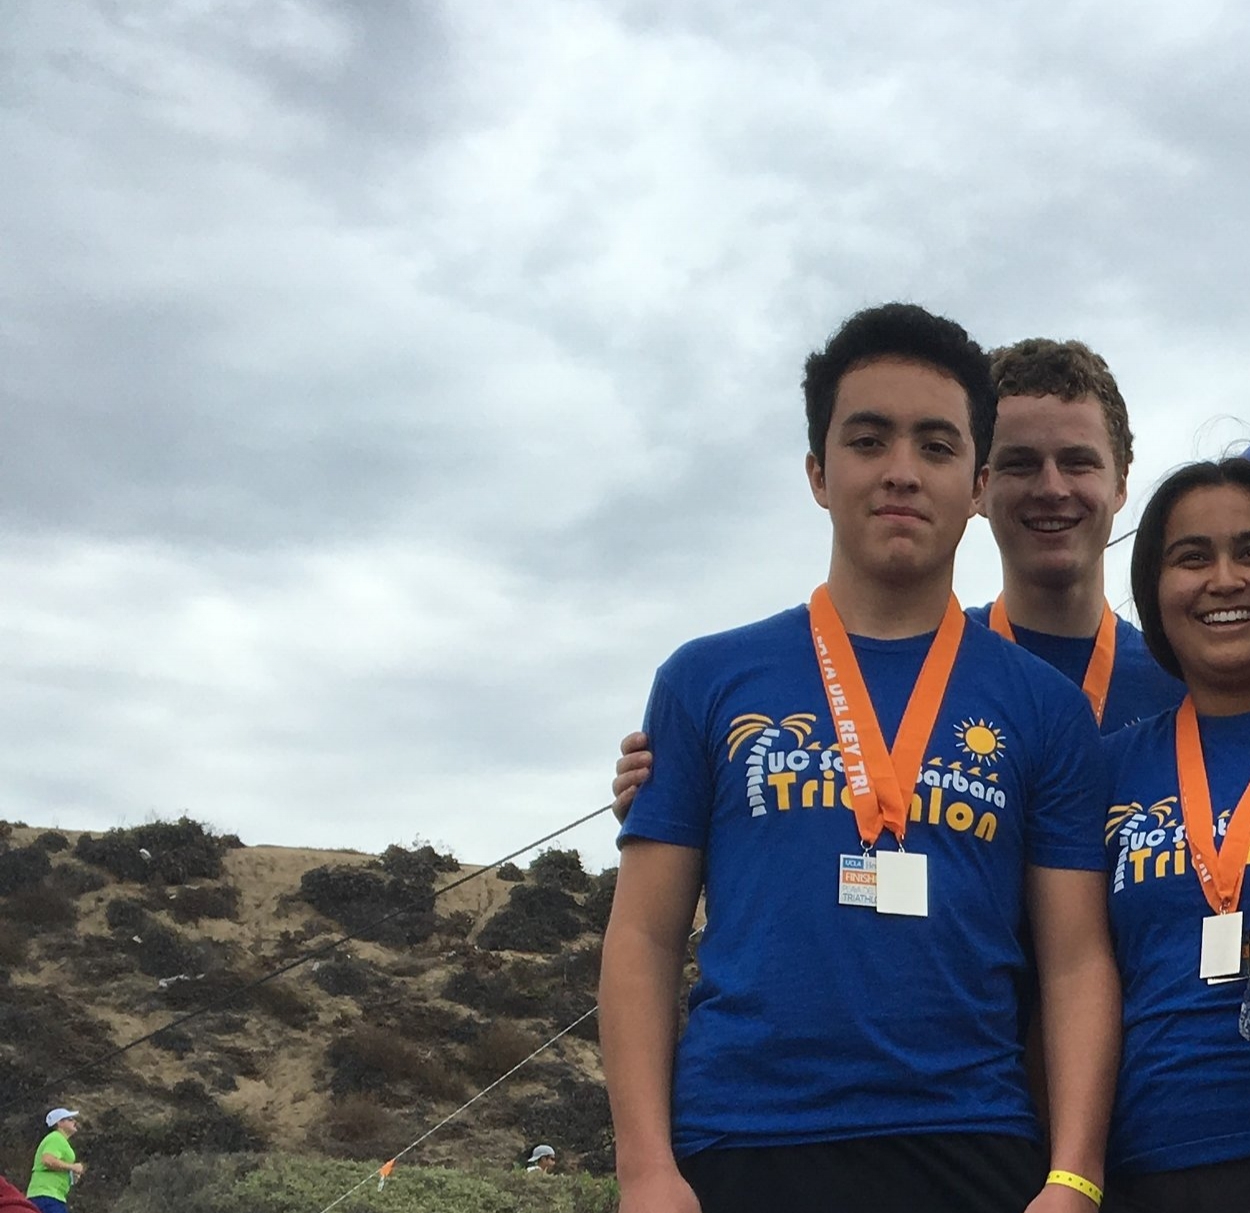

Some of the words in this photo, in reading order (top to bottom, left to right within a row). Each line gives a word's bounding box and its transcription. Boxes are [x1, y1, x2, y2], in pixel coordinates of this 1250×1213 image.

[828, 684, 850, 716] DEL
[838, 719, 862, 757] REY
[768, 749, 810, 773] UC
[847, 760, 871, 797] TRI
[1131, 828, 1167, 851] UC
[845, 859, 862, 867] UCLA
